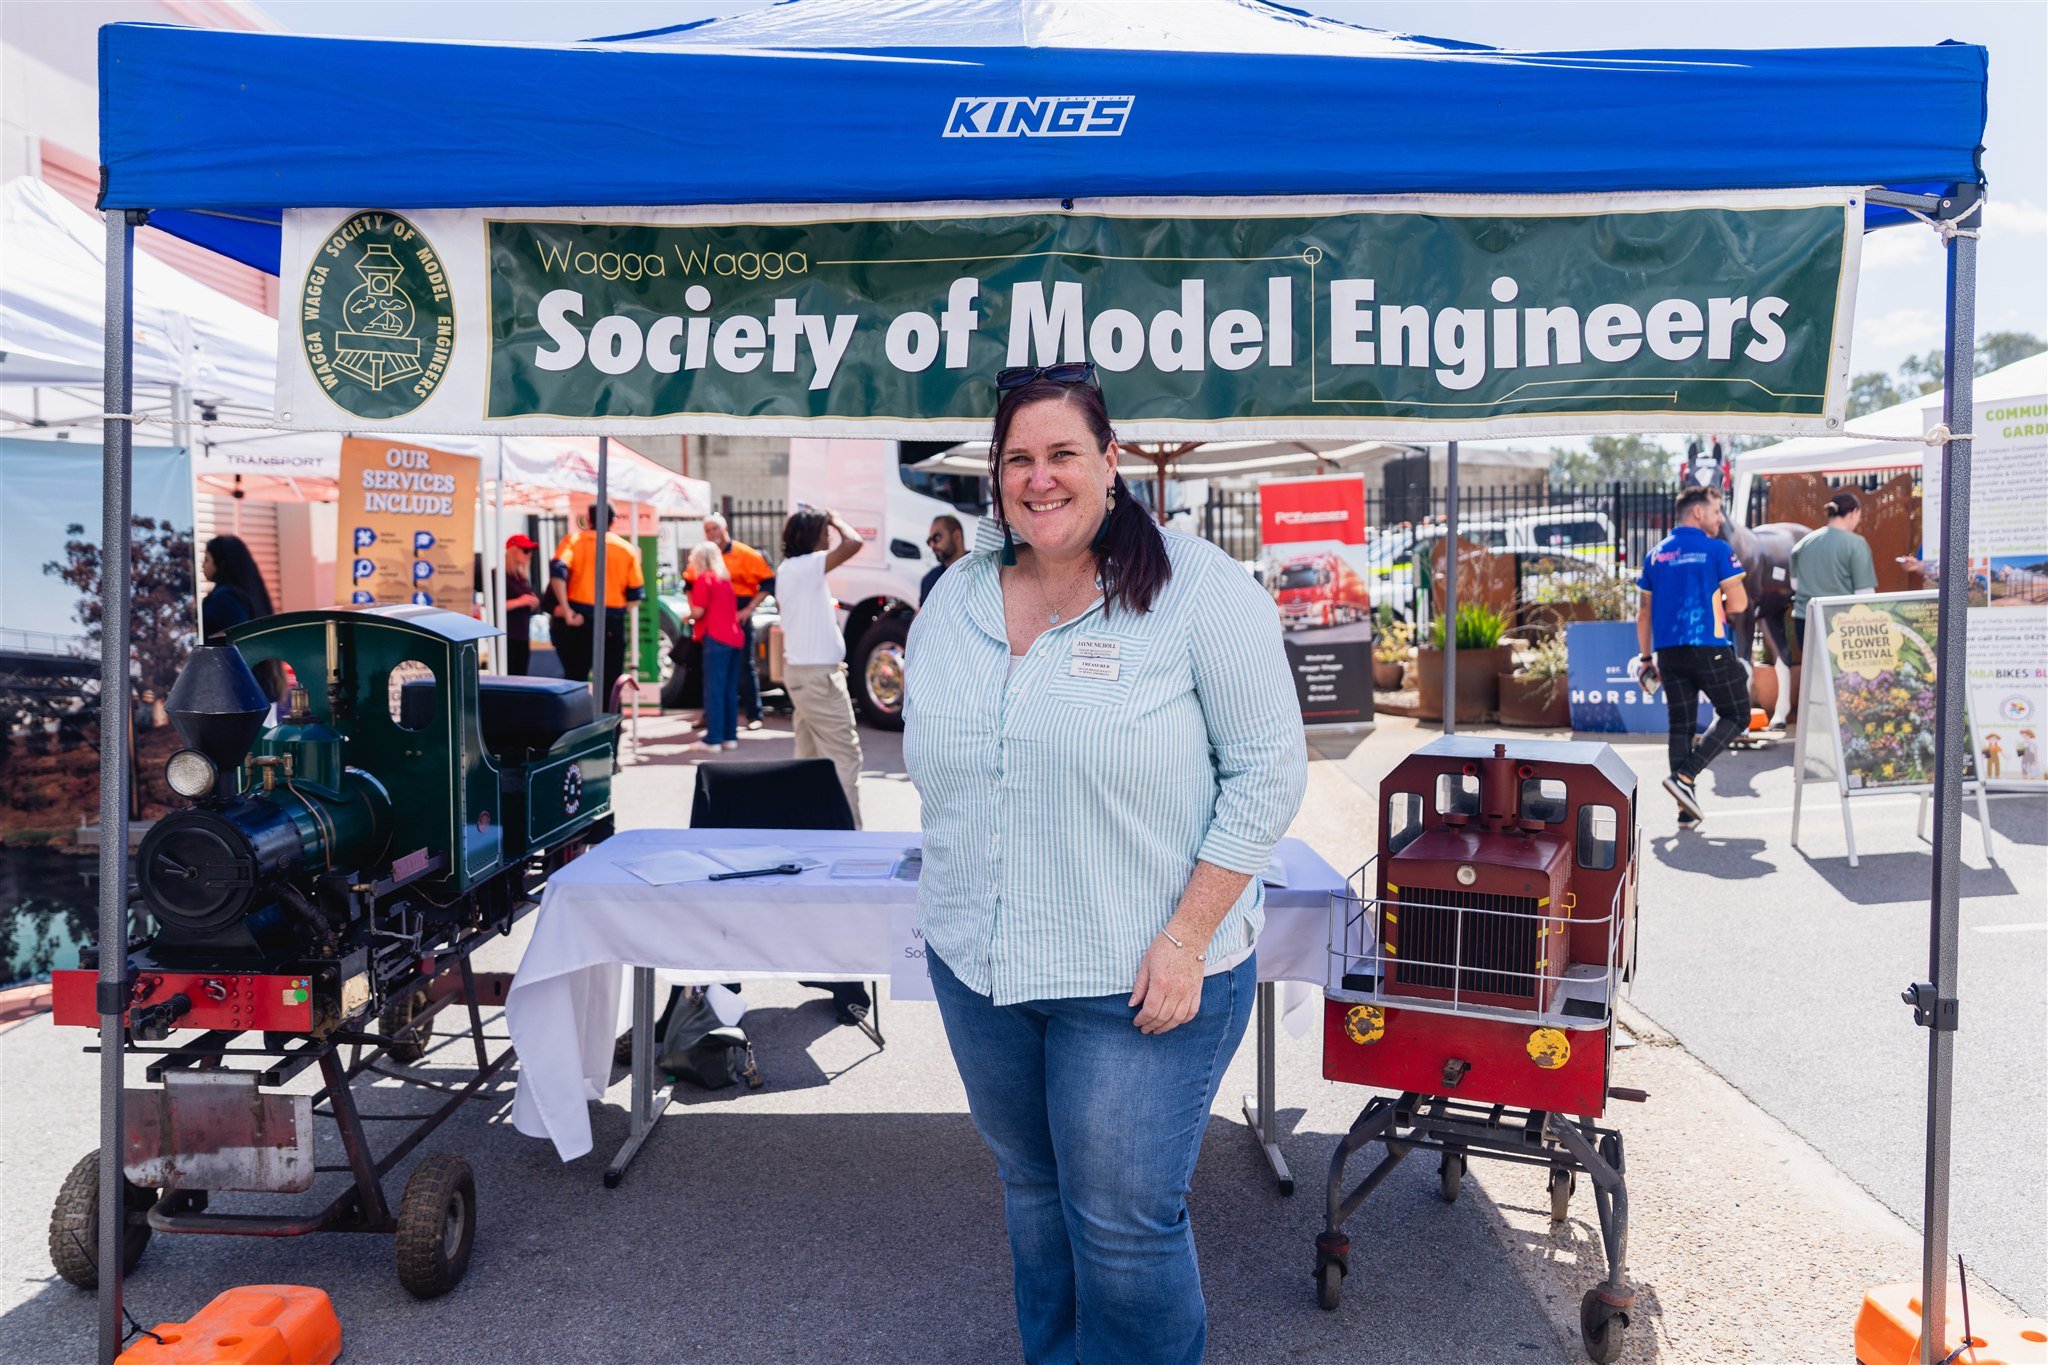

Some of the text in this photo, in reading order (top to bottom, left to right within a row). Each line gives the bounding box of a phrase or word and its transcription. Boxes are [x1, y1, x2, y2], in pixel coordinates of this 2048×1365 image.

[944, 96, 1134, 136] KINGS
[536, 239, 808, 282] Wagga Wagga
[304, 215, 452, 398] WAGGA WAGGA SOCIETY OF MODEL ENGINEERS
[534, 276, 1790, 391] Society of Model Engineers
[2002, 423, 2048, 438] GARD
[227, 454, 324, 467] TRANSPORT
[385, 448, 430, 470] OUR
[362, 469, 456, 495] SERVICES
[364, 492, 454, 516] INCLUDE
[1840, 624, 1889, 637] SPRING
[1841, 637, 1890, 649] FLOWER
[1843, 649, 1893, 660] FESTIVAL
